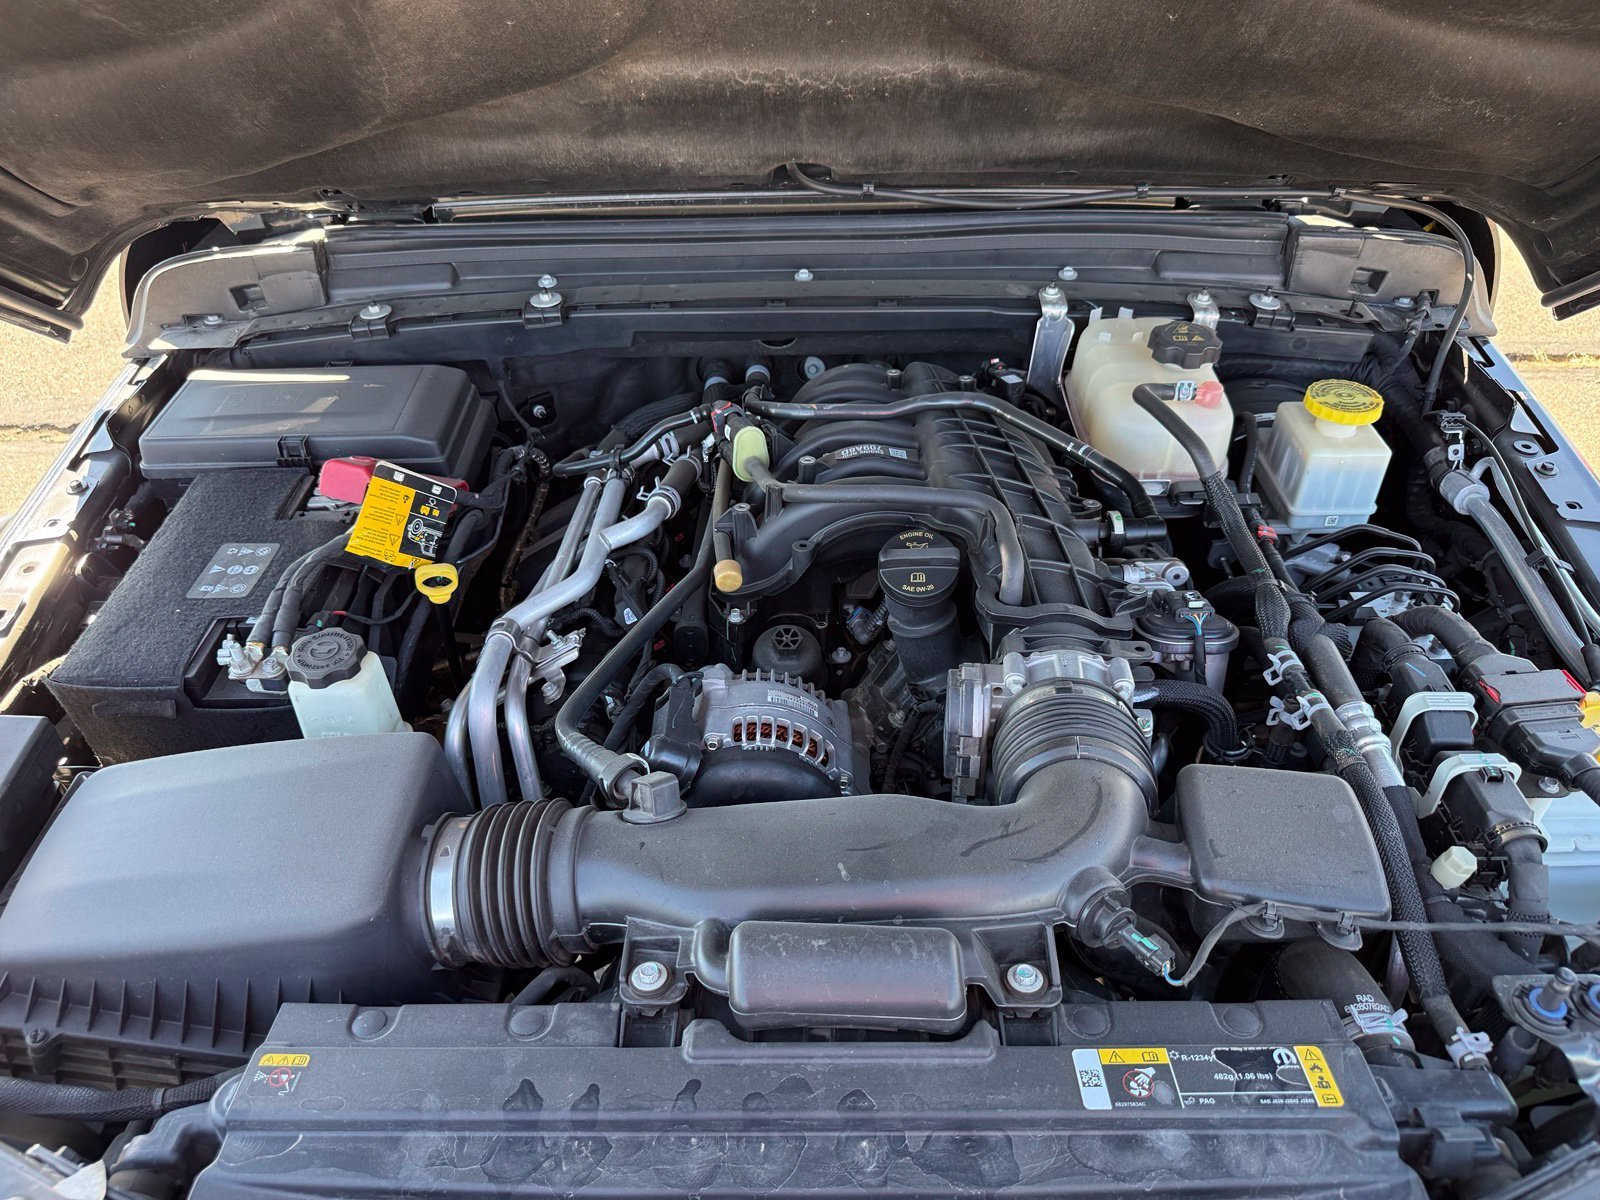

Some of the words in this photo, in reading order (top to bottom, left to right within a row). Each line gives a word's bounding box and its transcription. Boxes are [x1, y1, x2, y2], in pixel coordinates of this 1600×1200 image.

[900, 531, 924, 540] ENGINE
[924, 532, 934, 540] OIL
[902, 584, 916, 592] SAE
[1355, 994, 1375, 1003] RAD
[1213, 1073, 1235, 1082] 482g
[1256, 1072, 1274, 1081] lbs)
[1199, 1097, 1216, 1105] PAG
